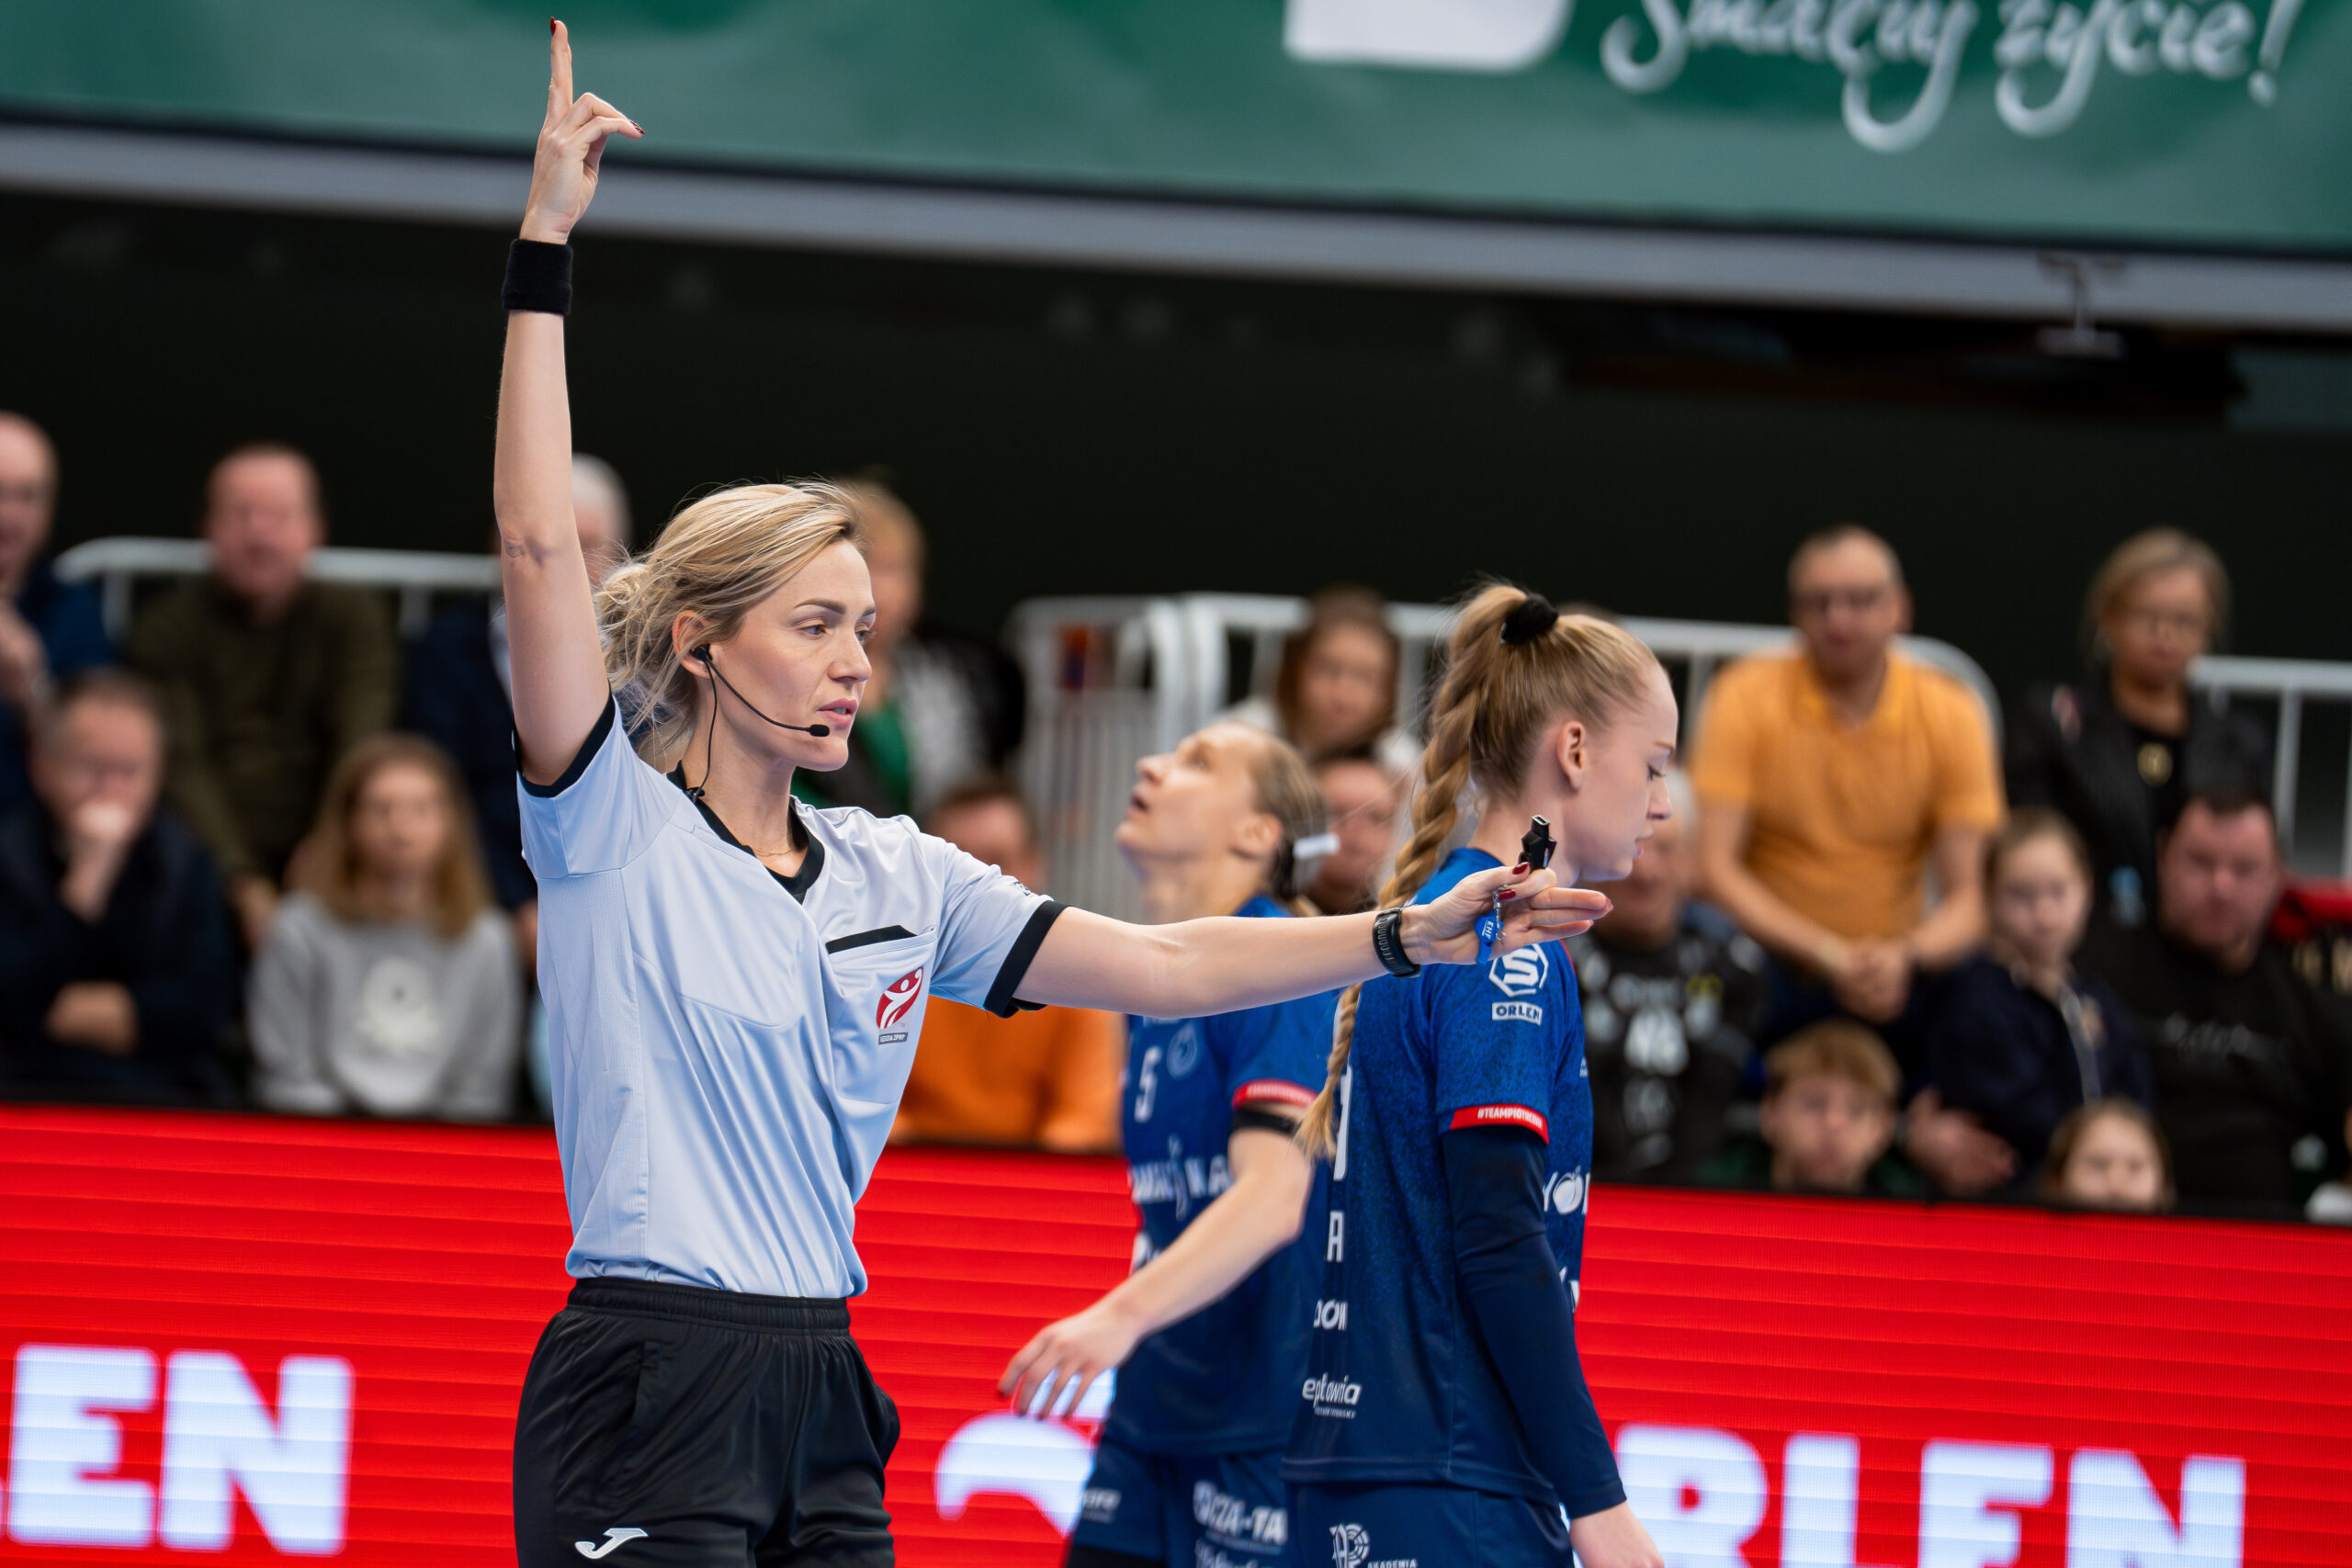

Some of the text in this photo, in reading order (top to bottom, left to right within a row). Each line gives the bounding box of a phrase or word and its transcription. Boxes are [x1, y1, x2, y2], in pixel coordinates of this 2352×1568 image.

[1485, 921, 1494, 940] EHF
[1495, 1005, 1541, 1020] ORLEN
[0, 1342, 355, 1555] EN
